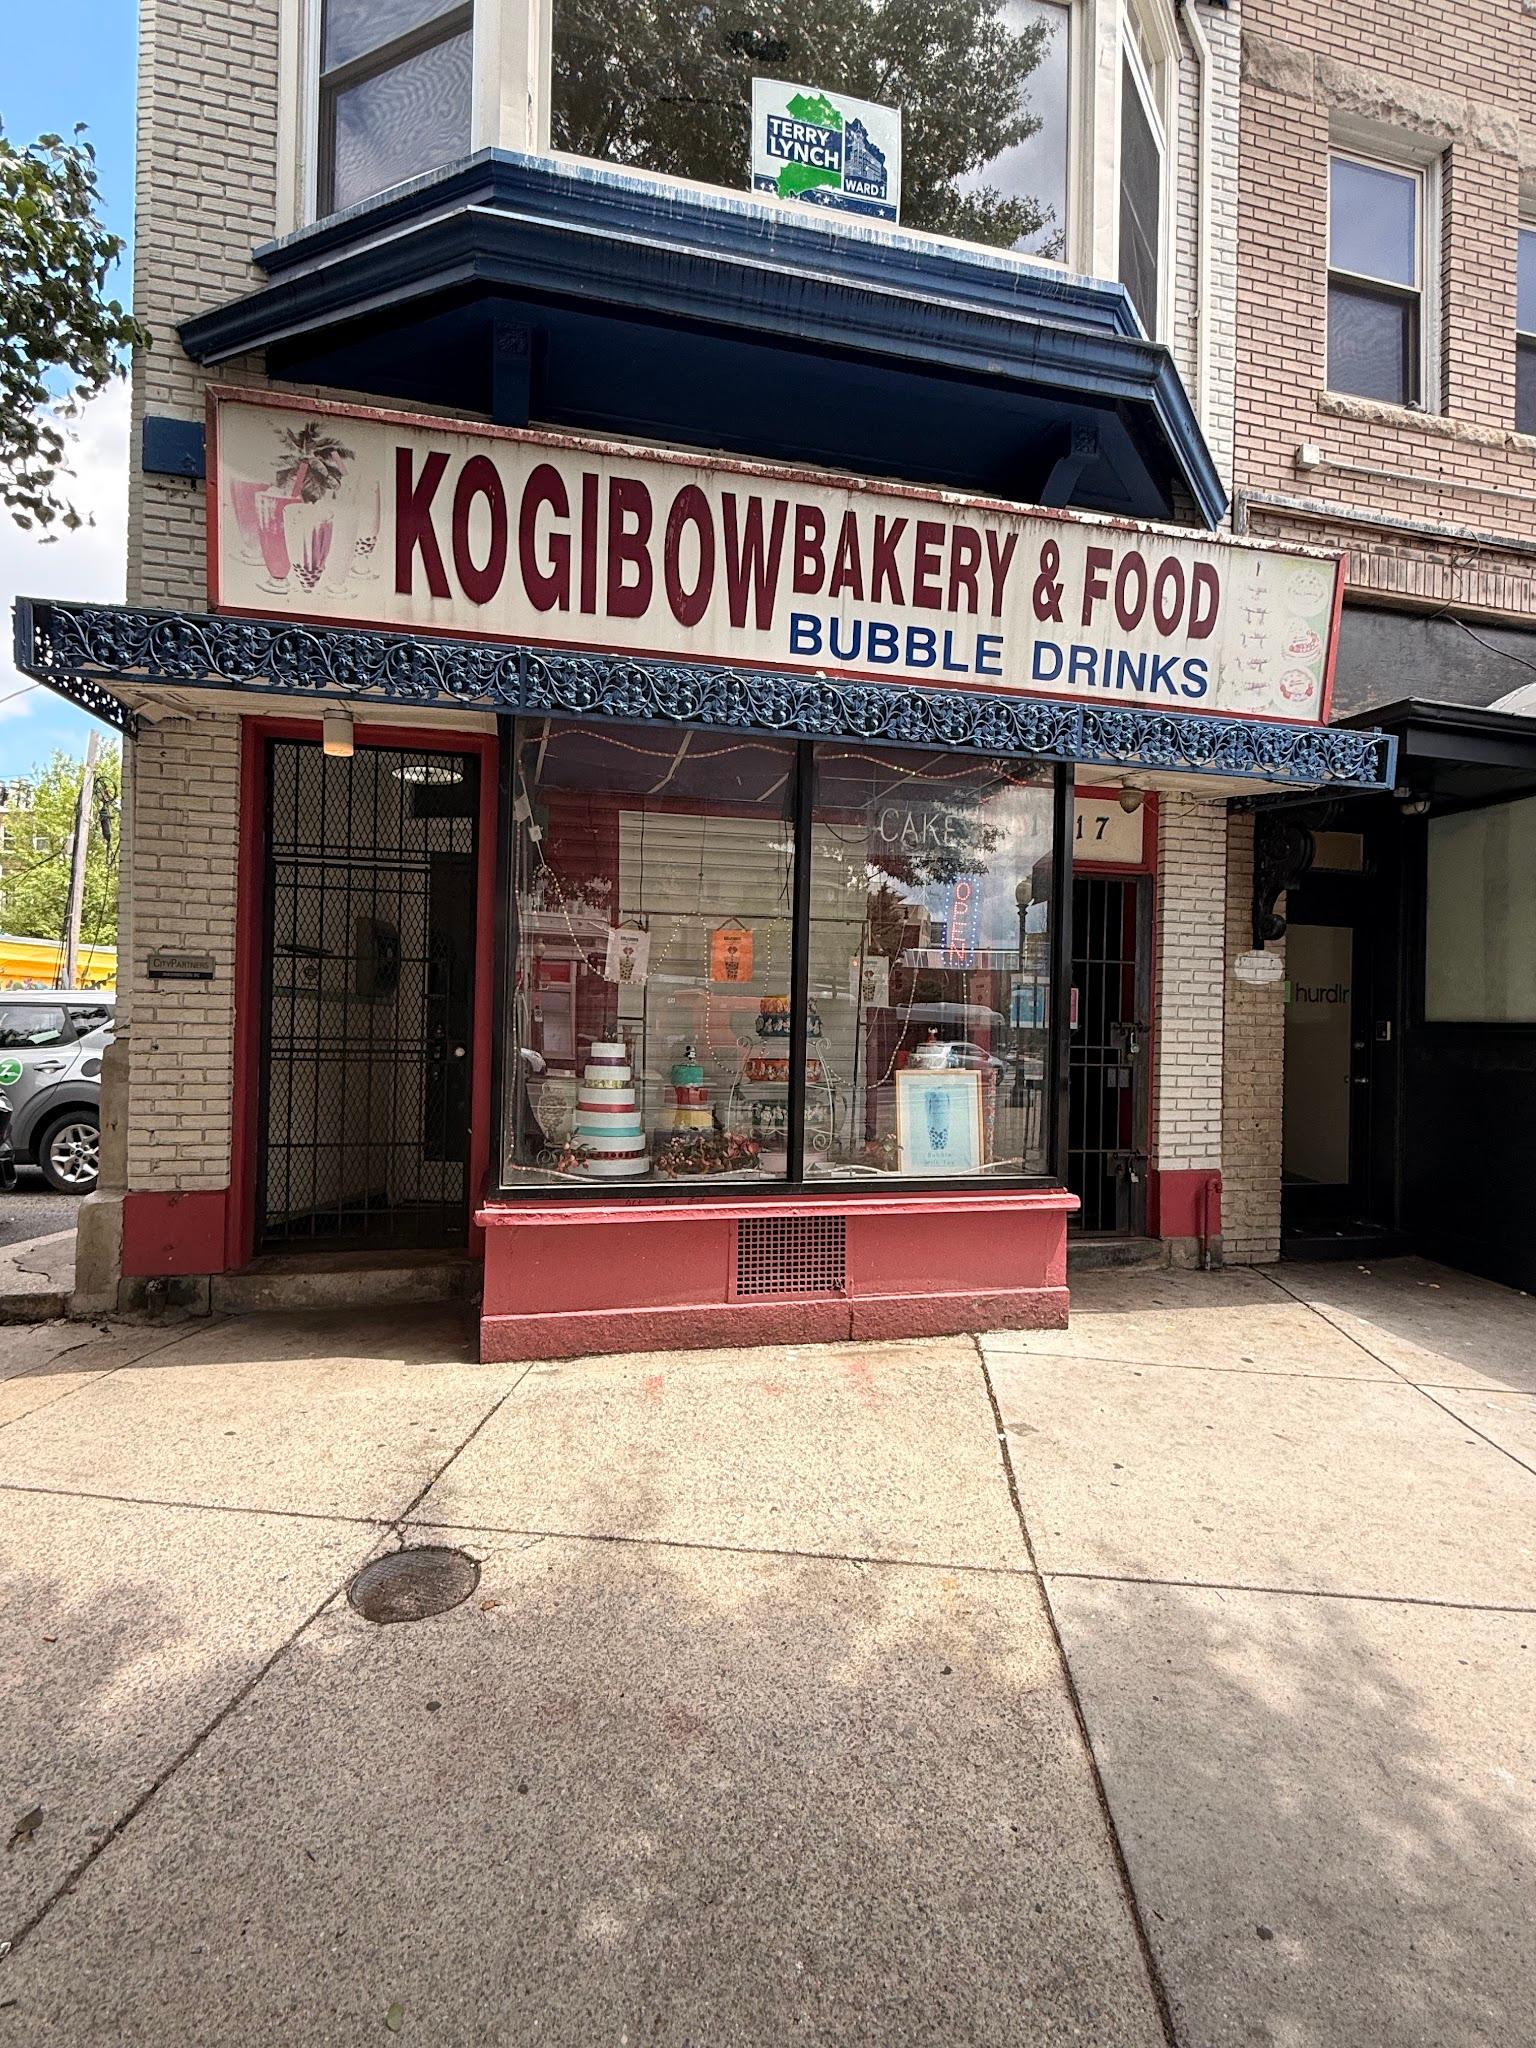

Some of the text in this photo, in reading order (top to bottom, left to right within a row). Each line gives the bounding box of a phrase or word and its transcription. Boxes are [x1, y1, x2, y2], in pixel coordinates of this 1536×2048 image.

[769, 118, 830, 147] TERRY
[769, 135, 839, 170] LYNCH
[845, 178, 887, 198] WARD 1
[395, 446, 1220, 640] KOGIBOW BAKERY & FOOD
[789, 612, 1209, 699] BUBBLE DRINKS
[880, 807, 959, 847] CAKE
[949, 881, 973, 964] OPEN
[1295, 982, 1350, 1004] hurdlr
